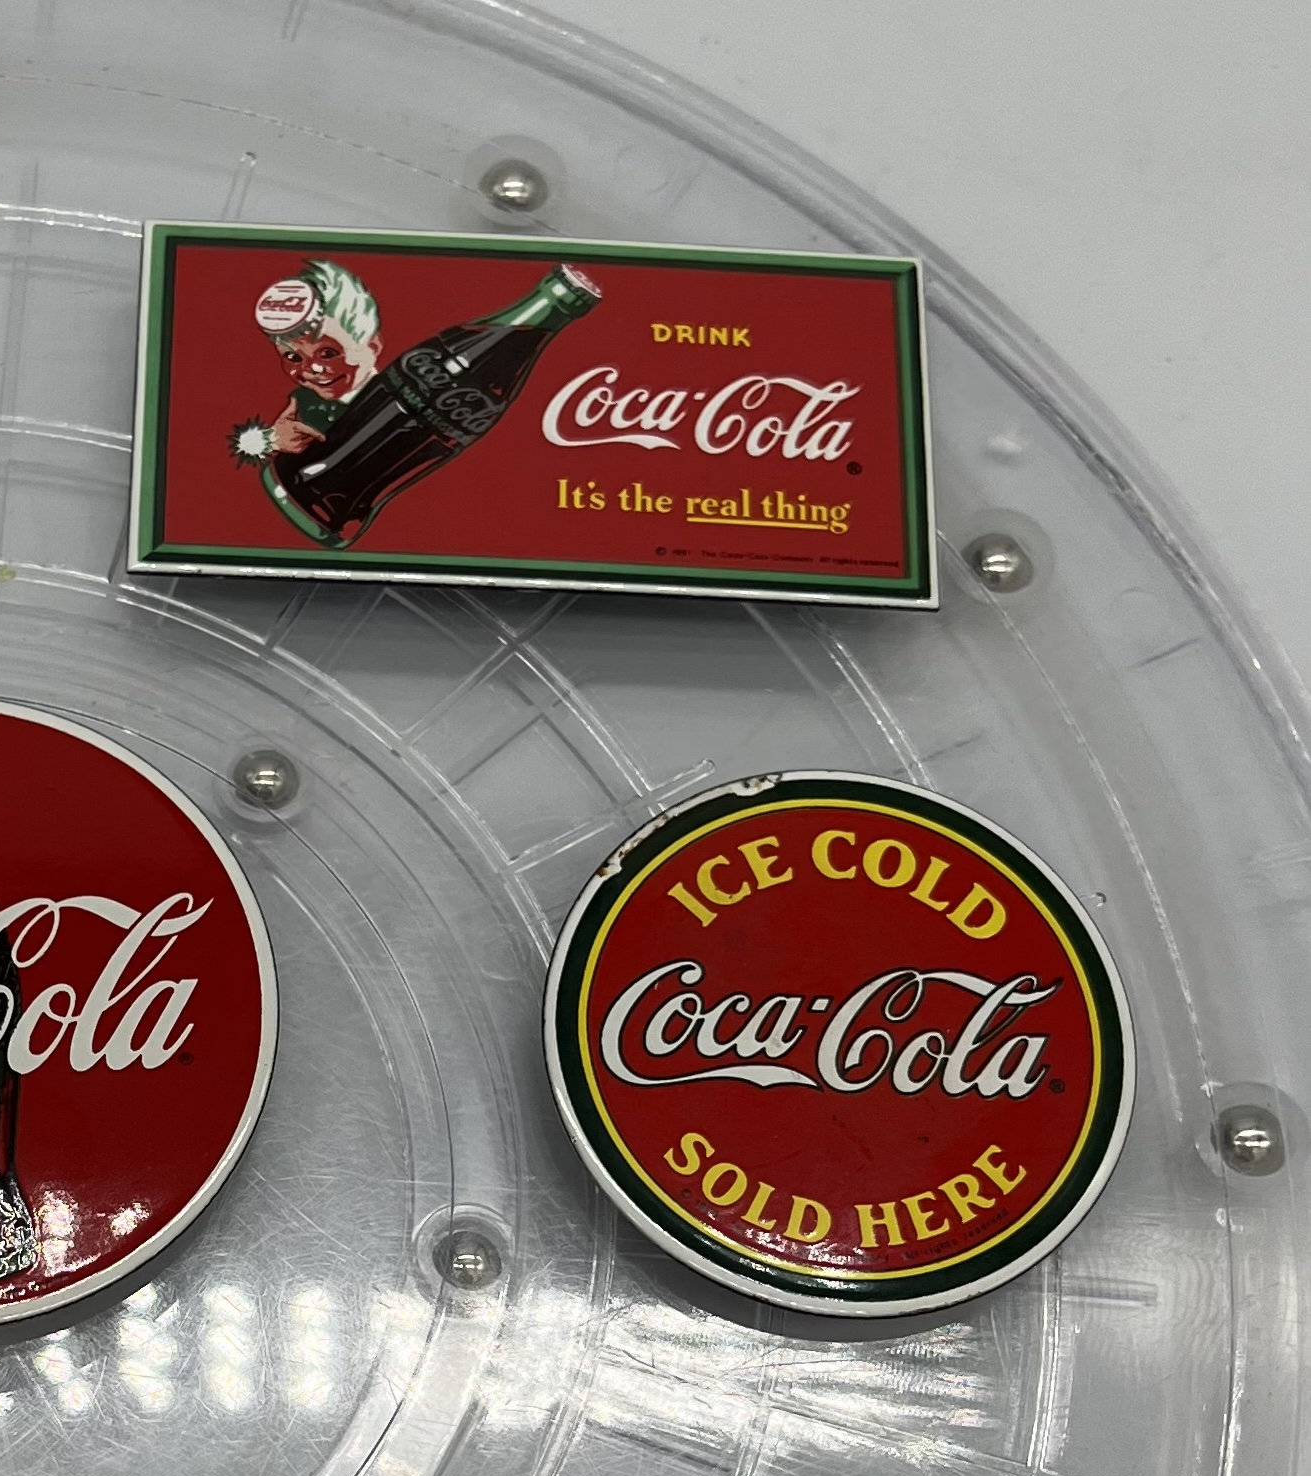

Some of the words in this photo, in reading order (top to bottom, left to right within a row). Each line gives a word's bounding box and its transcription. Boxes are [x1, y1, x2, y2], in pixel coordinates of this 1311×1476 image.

[649, 322, 752, 348] DRINK
[541, 366, 862, 462] Coca-Cola
[556, 478, 606, 511] It's
[619, 483, 672, 514] the
[686, 487, 751, 520] real
[760, 491, 851, 534] thing
[668, 835, 793, 928] ICE
[811, 830, 1008, 940] COLD
[600, 960, 1064, 1099] Coca-Cola
[663, 1131, 832, 1246] SOLD
[854, 1144, 1027, 1249] HERE
